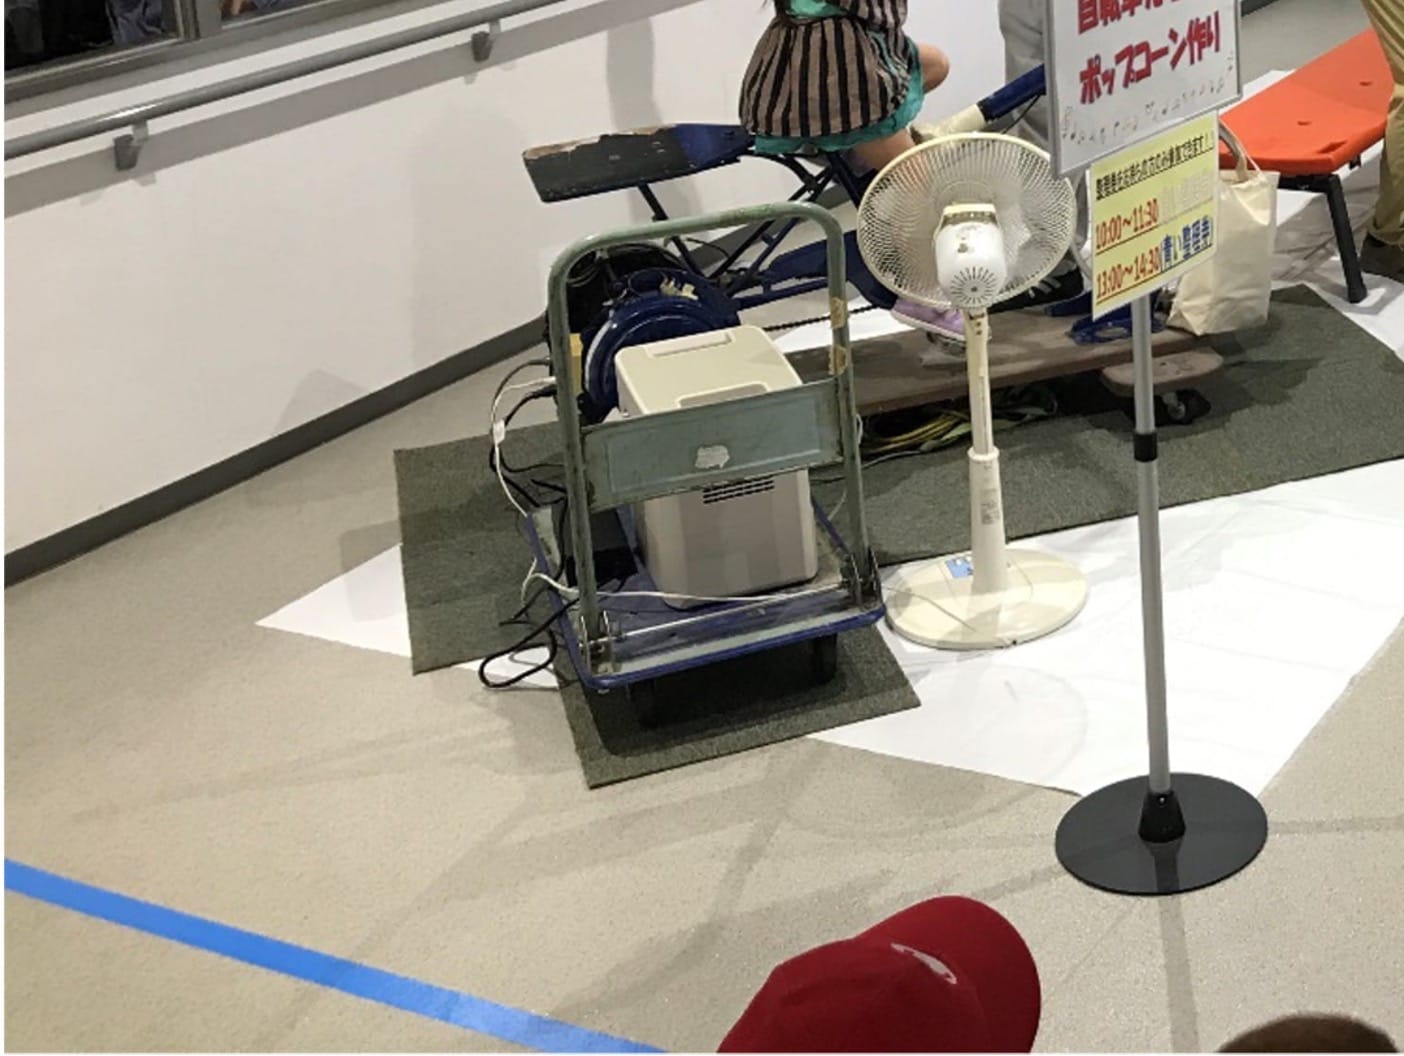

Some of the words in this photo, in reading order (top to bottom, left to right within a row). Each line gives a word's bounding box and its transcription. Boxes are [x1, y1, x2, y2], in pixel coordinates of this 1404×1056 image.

[1080, 10, 1220, 104] ポップコーン作り
